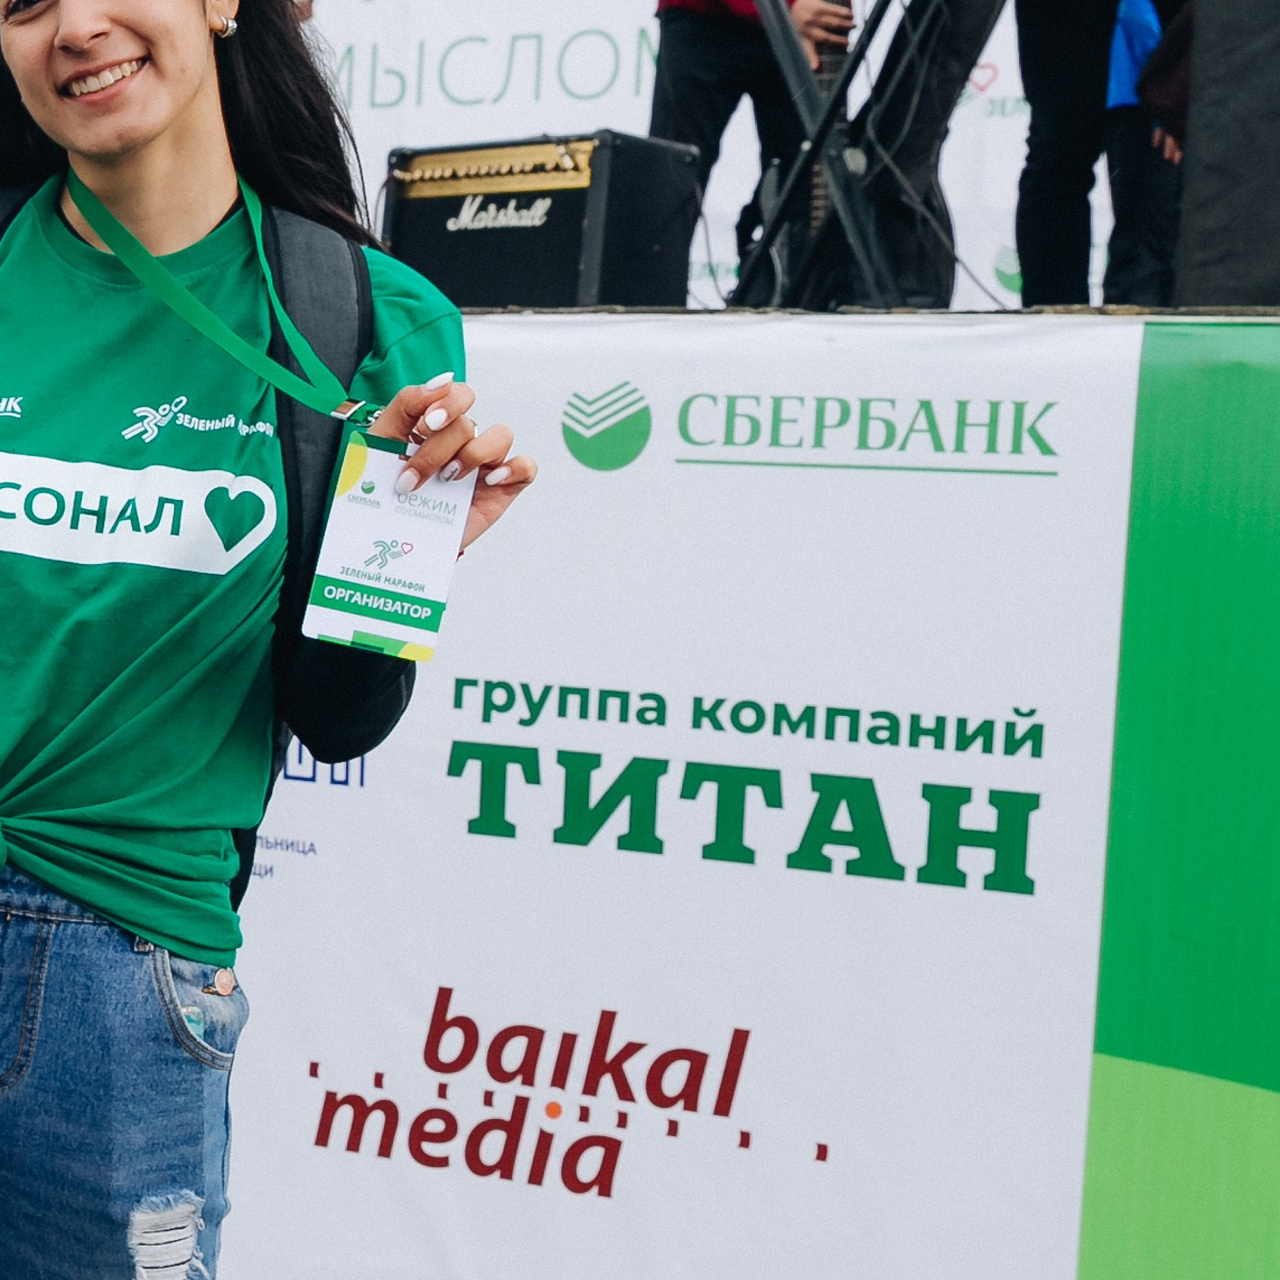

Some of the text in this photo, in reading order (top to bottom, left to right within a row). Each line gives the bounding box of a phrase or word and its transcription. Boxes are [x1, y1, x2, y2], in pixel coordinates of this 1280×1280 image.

[446, 194, 553, 232] Marshall
[175, 412, 236, 431] ЗЕЛЕНЫЙ
[677, 392, 1061, 458] СБЕРБАНК
[323, 584, 432, 620] ОРГАНИЗАТОР
[339, 565, 426, 593] ЗЕЛЕНЫЙ МАРАФОН
[452, 676, 1046, 759] группа компаний
[446, 739, 1042, 896] ТИТАН
[256, 834, 318, 857] ЛЬНИЦА
[422, 986, 751, 1118] baikal
[313, 1094, 624, 1199] media
